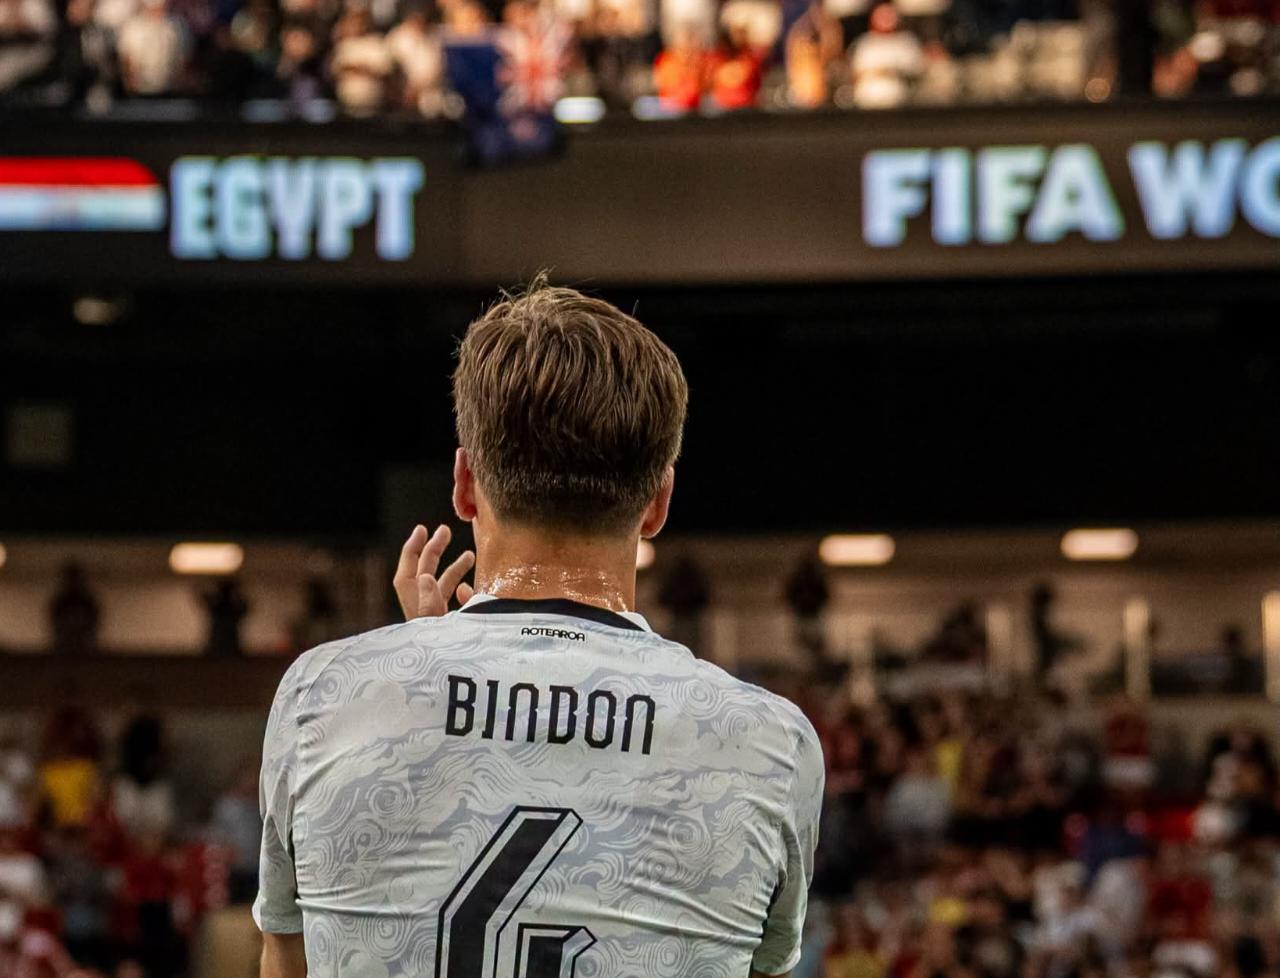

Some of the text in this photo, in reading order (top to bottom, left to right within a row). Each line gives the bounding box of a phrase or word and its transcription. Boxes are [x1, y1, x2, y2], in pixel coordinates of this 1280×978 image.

[170, 155, 424, 261] EGYPT
[862, 144, 1124, 247] FIFA
[520, 626, 586, 642] AOTEAROA
[445, 674, 656, 755] BINDON
